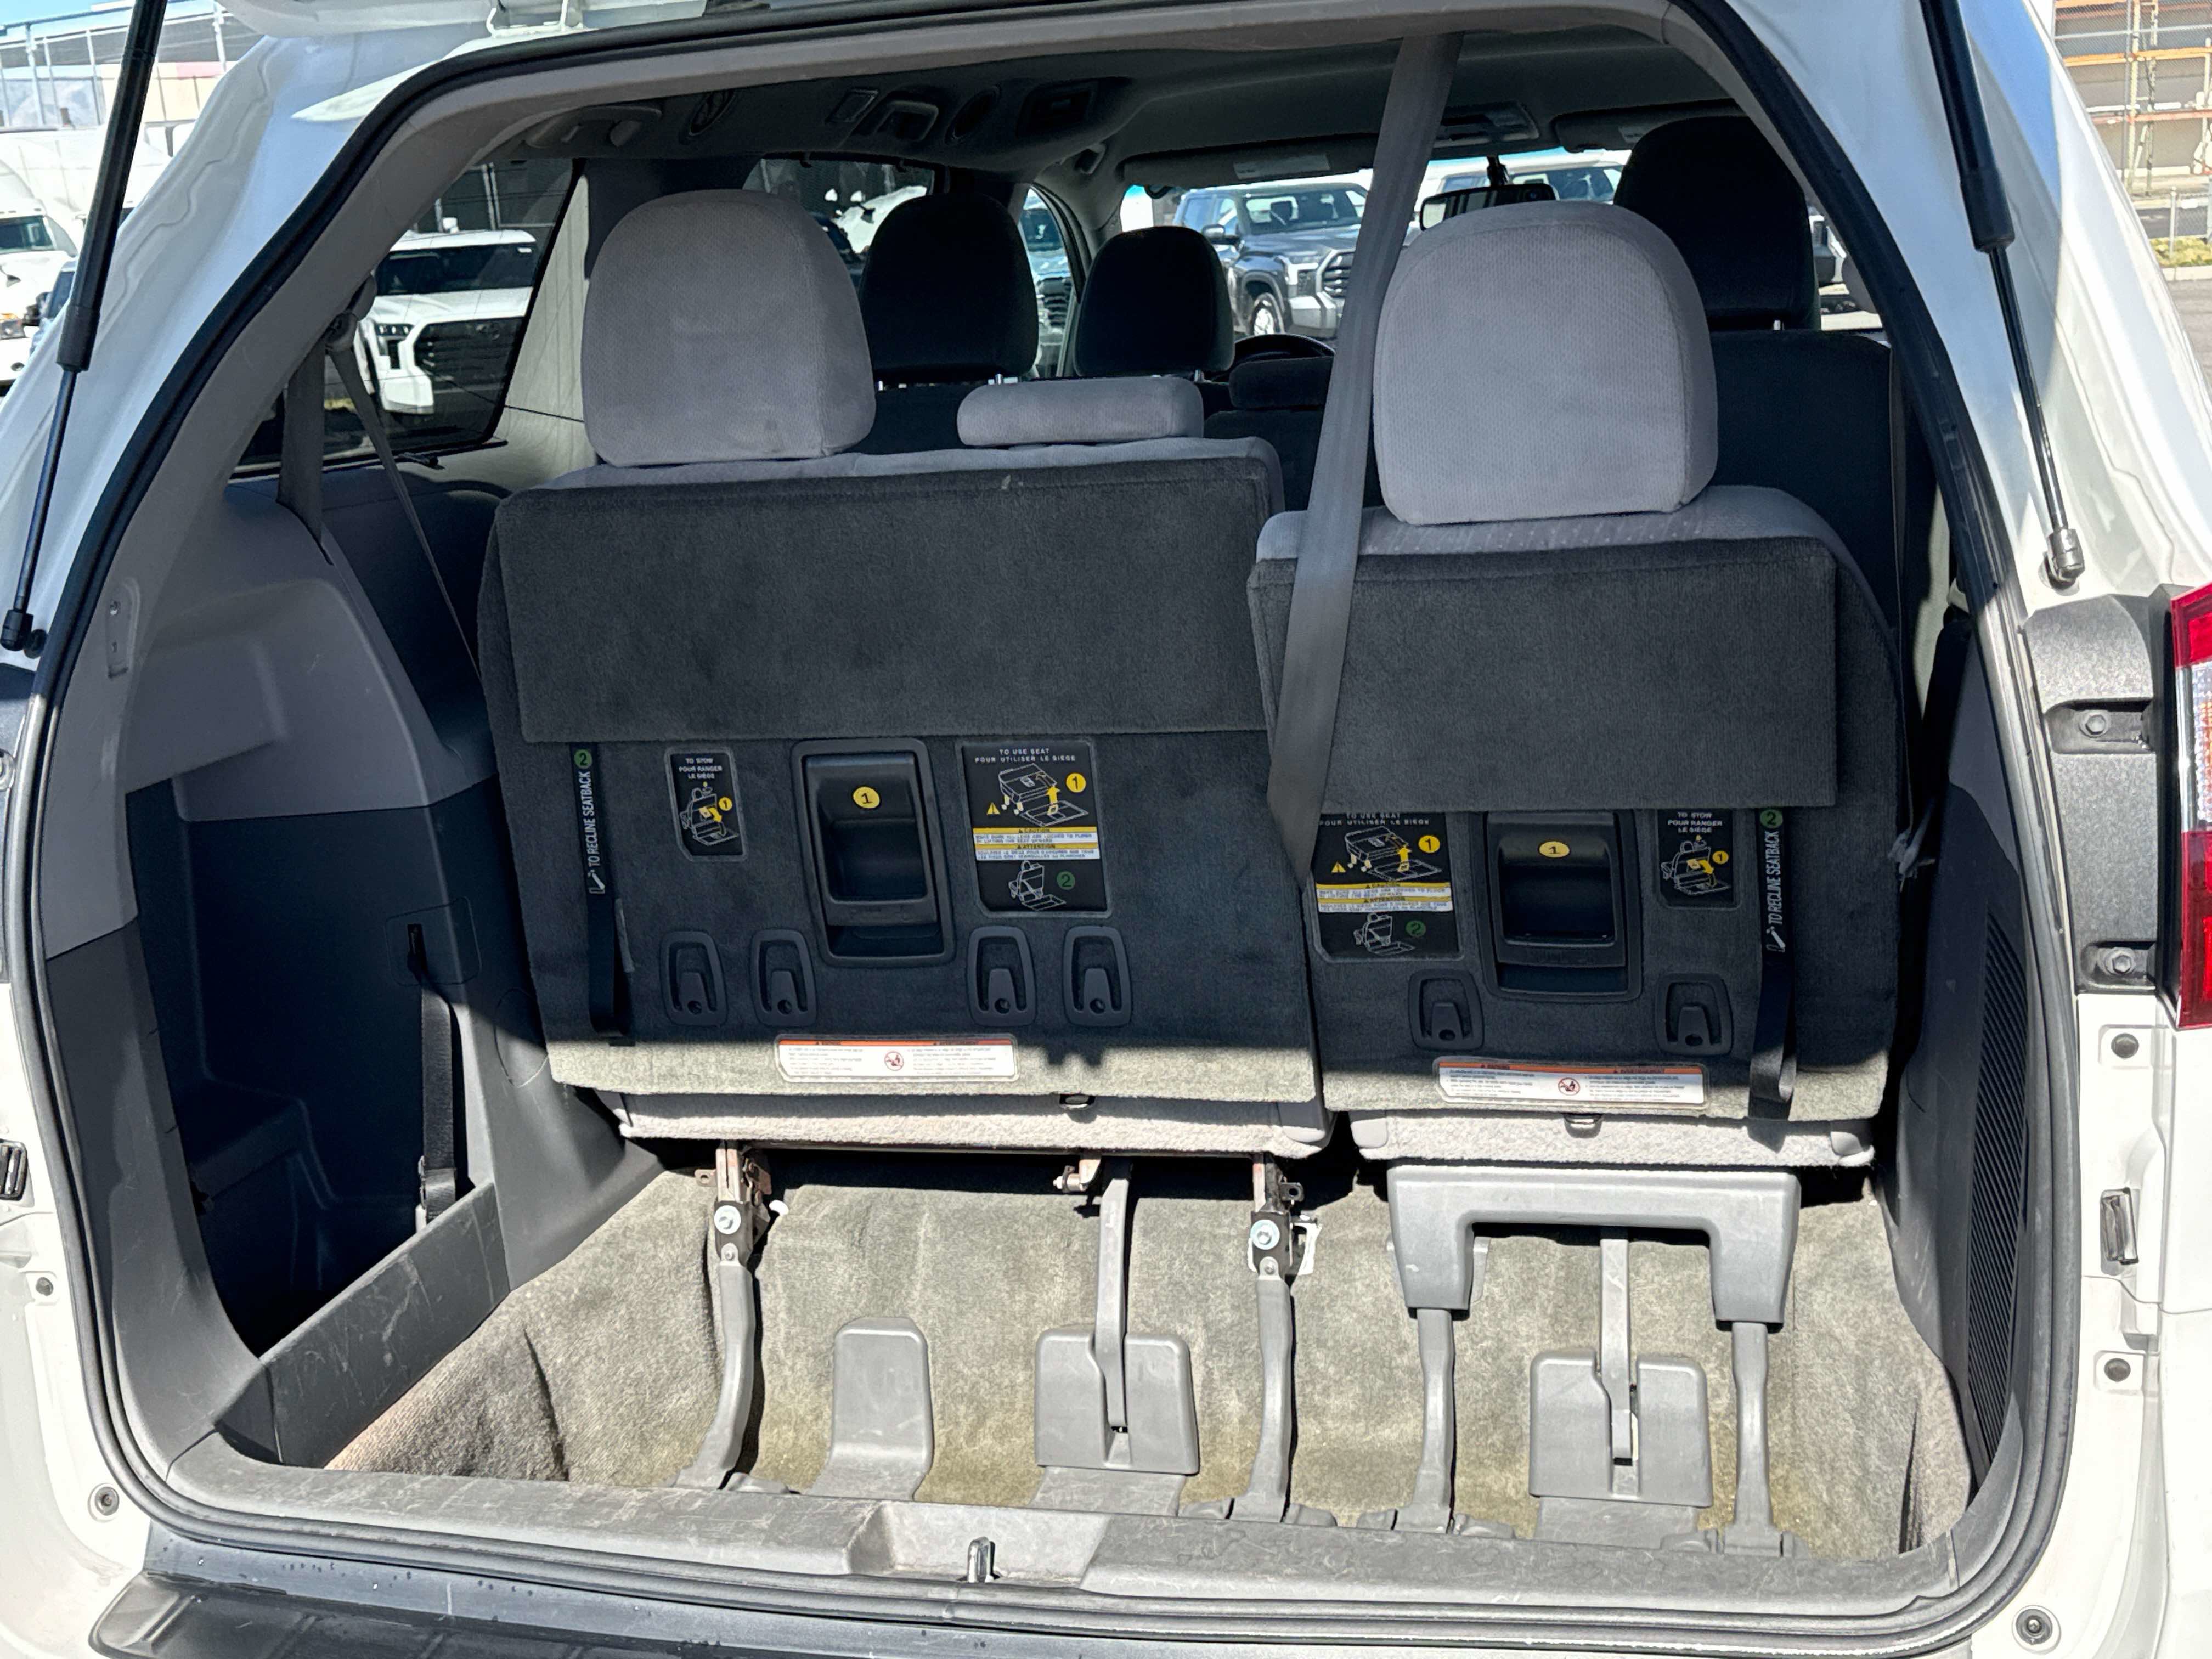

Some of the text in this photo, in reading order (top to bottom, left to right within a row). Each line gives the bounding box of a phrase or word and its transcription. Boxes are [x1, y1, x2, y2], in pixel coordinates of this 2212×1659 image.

[579, 752, 588, 766] 2
[862, 793, 873, 804] 1
[578, 771, 601, 867] TO RECLINE SEATBACK
[1767, 811, 1777, 825] 2
[1549, 845, 1560, 854] 1
[1062, 873, 1073, 888] 2
[1764, 831, 1783, 925] TO RECLINE SEATBACK
